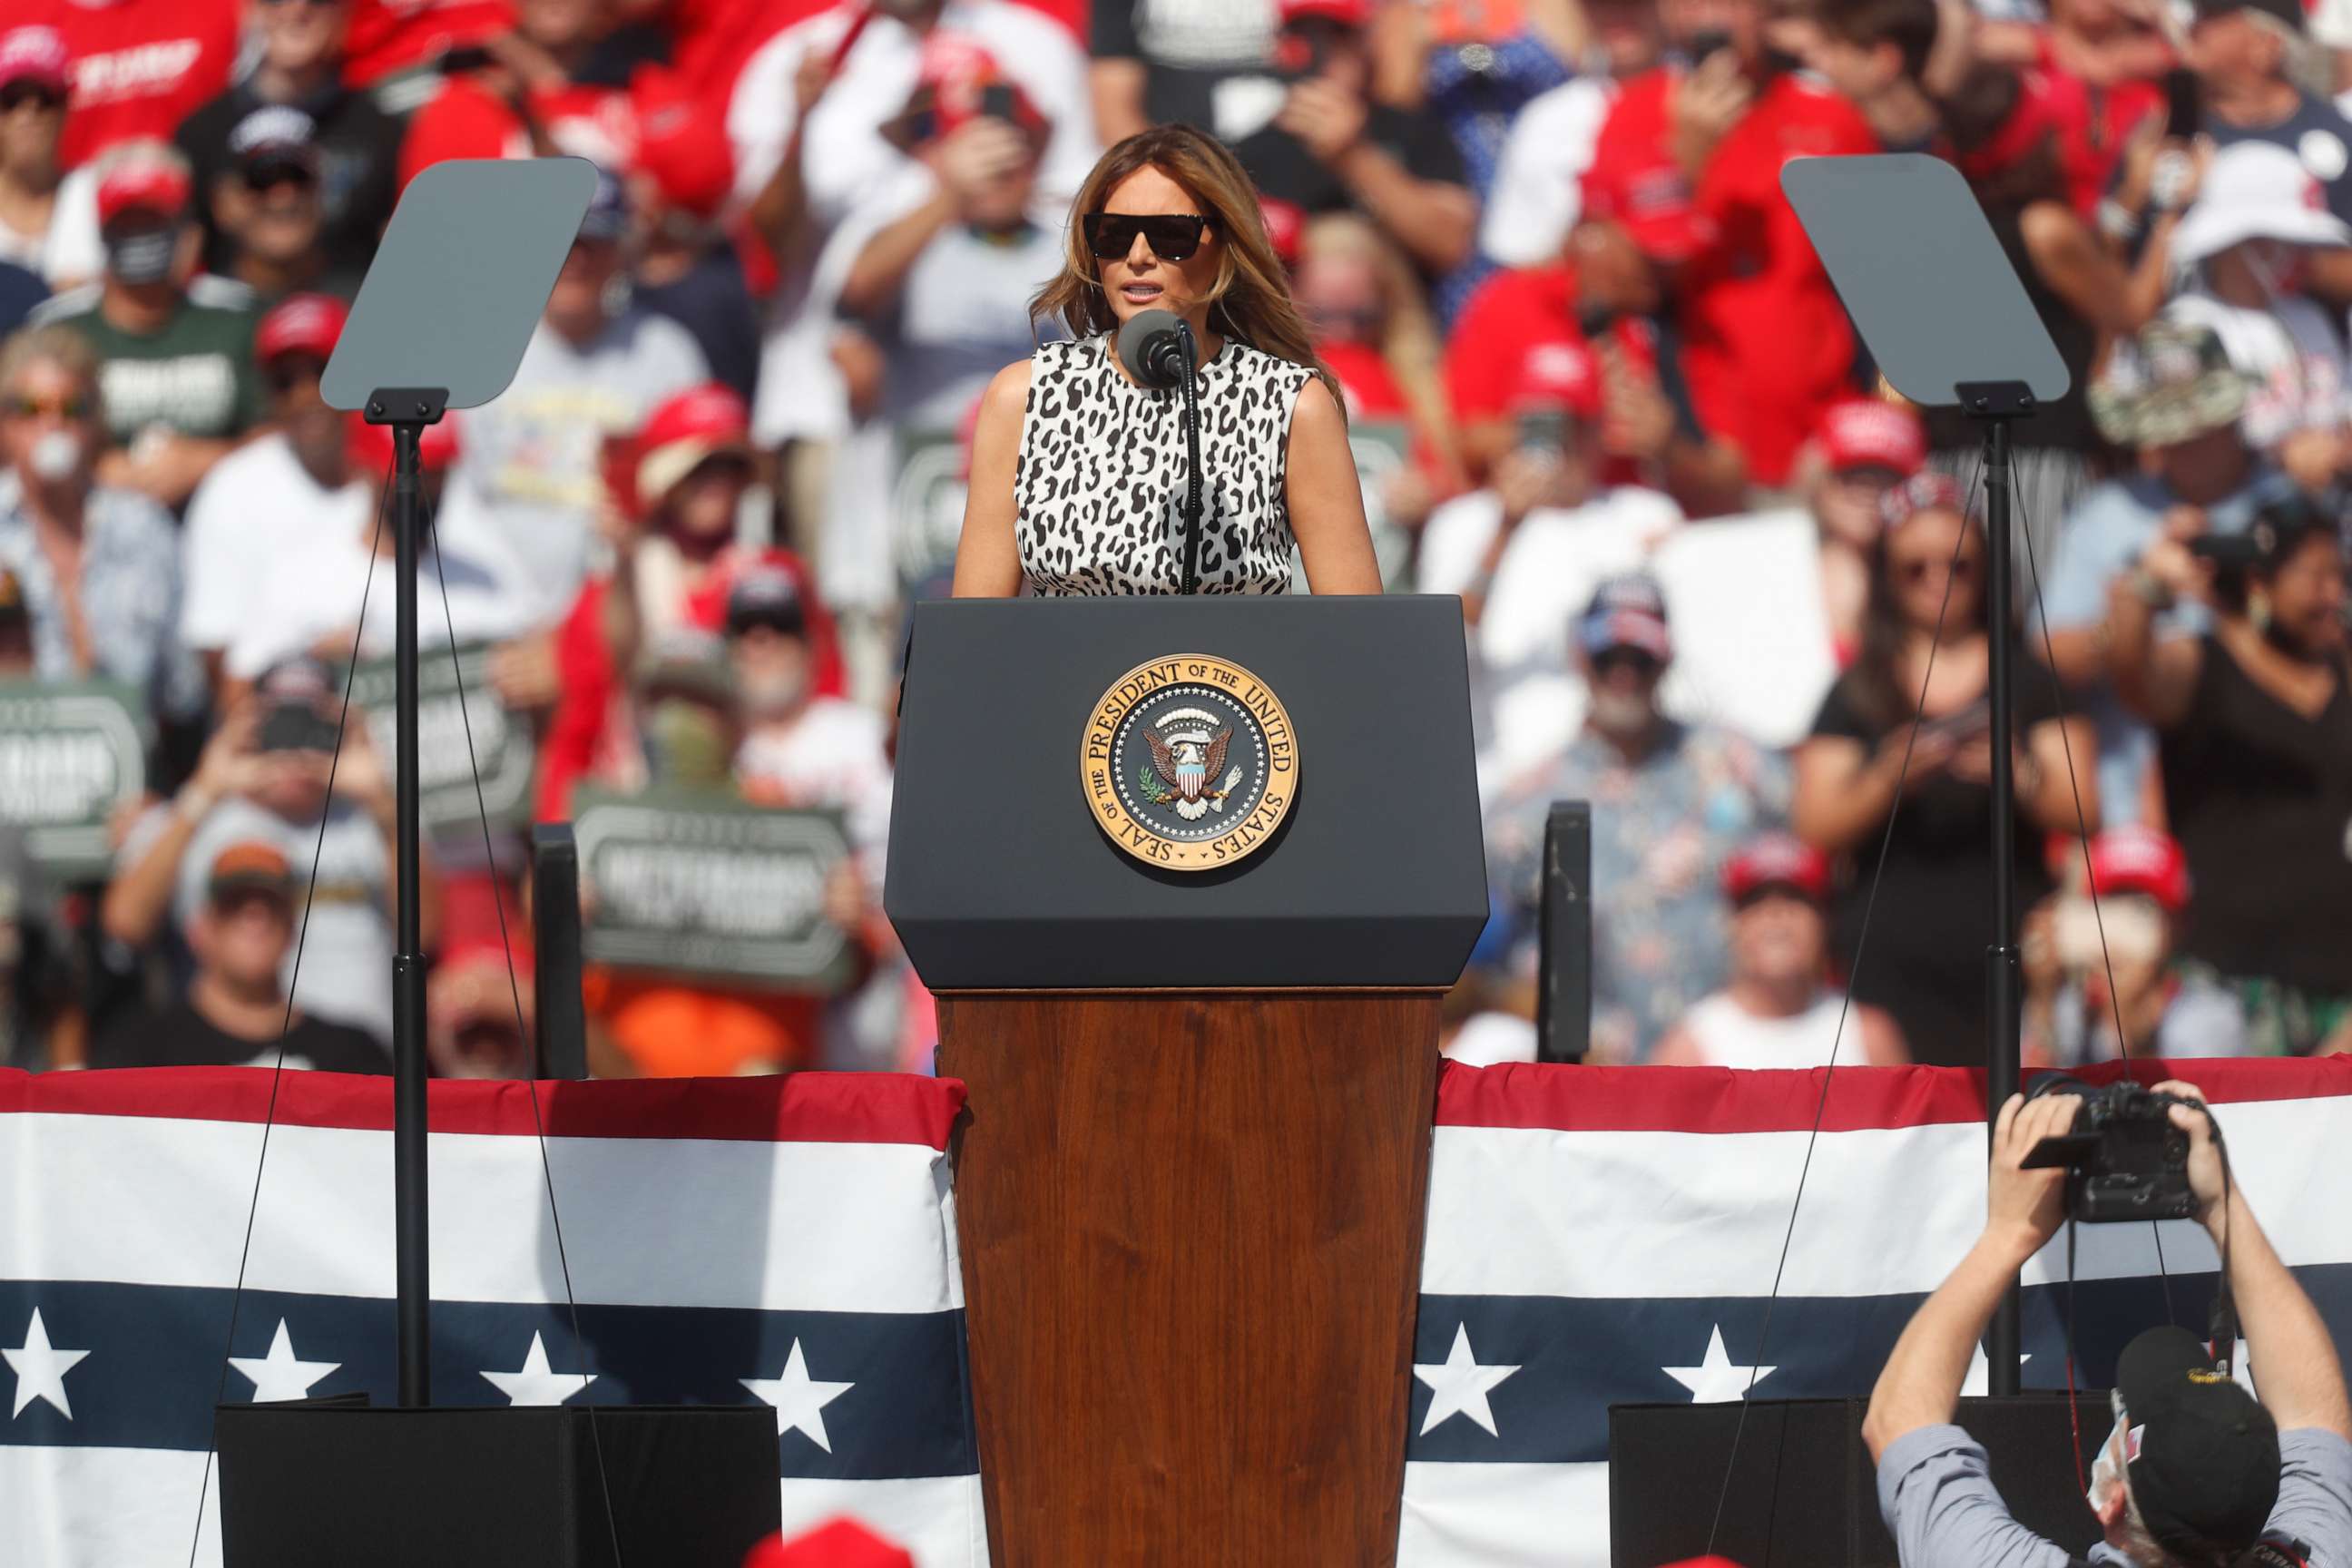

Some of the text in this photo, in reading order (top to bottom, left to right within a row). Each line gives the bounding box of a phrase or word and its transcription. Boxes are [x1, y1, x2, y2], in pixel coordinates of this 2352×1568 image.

[1089, 662, 1291, 861] SEAL OF THE PRESIDENT OF THE UNITED STATES
